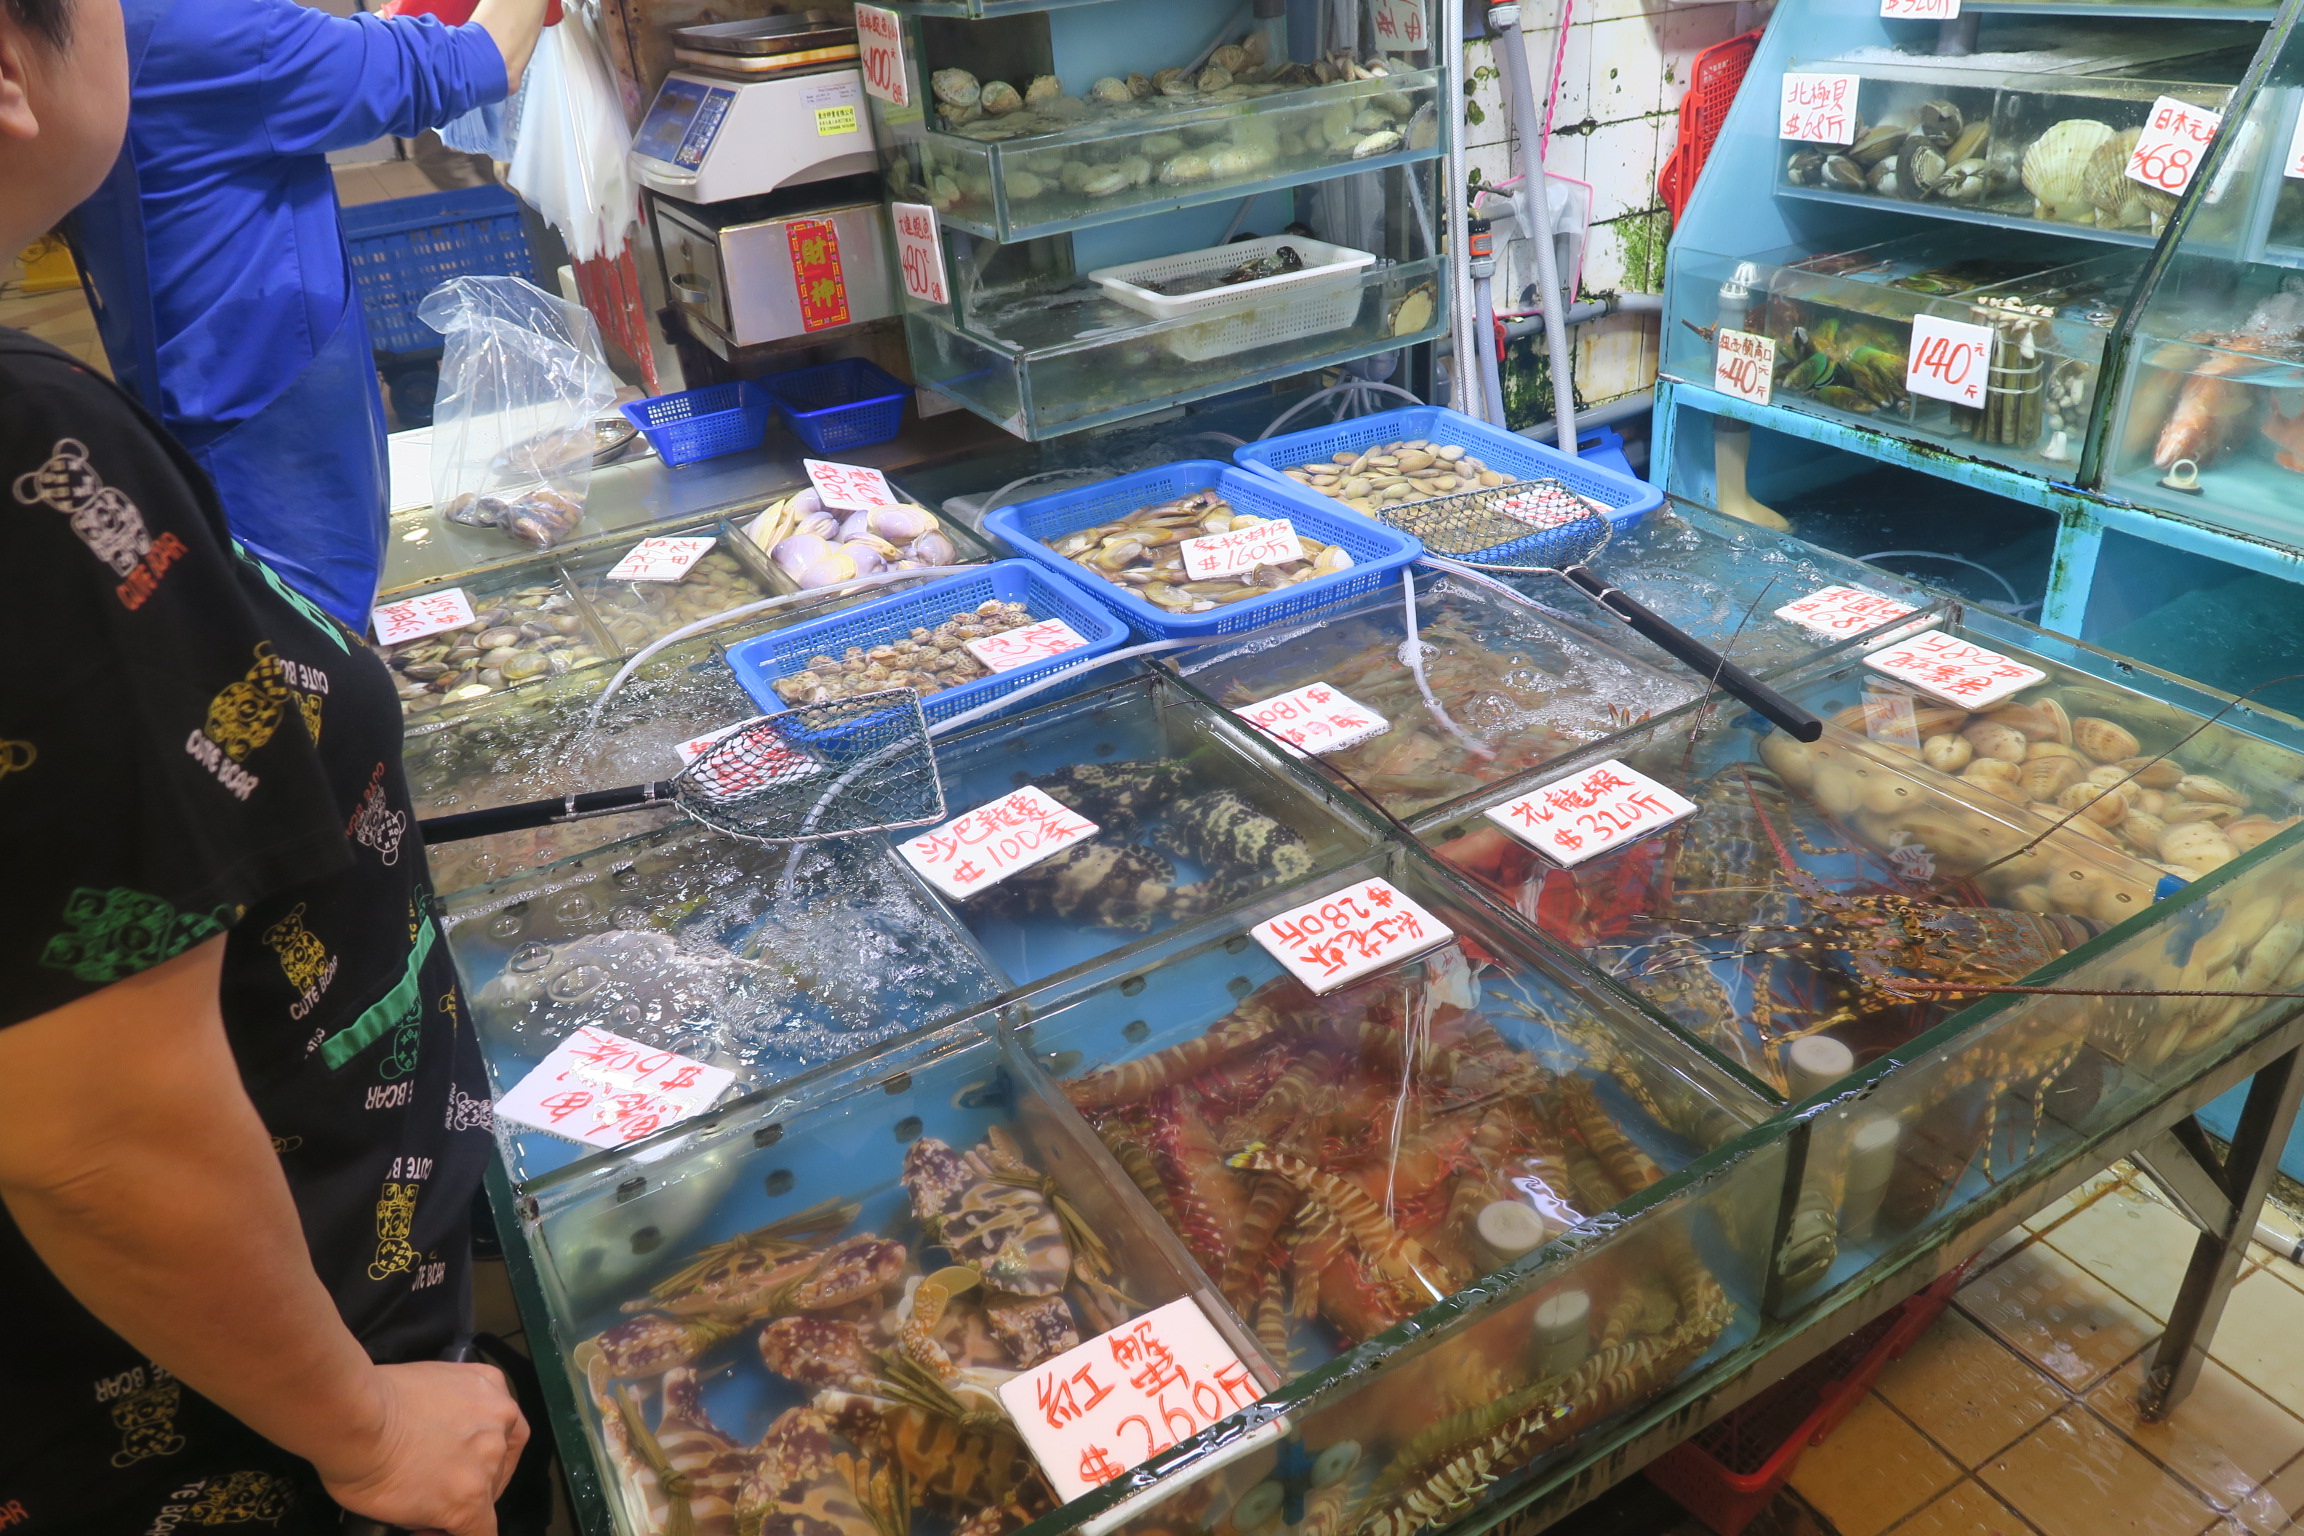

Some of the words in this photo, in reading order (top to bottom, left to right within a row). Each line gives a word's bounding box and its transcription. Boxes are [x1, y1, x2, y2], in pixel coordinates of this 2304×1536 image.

[1788, 79, 1847, 111] 北極貝
[1783, 112, 1846, 143] $68斤
[2132, 143, 2193, 188] $68
[802, 235, 835, 308] 財神
[1197, 535, 1290, 572] $160斤
[1913, 634, 2034, 679] $68斤
[1511, 769, 1636, 827] 花龍蝦
[1553, 790, 1674, 851] $320斤
[1270, 886, 1393, 949] $280斤
[289, 985, 320, 1021] CUTE
